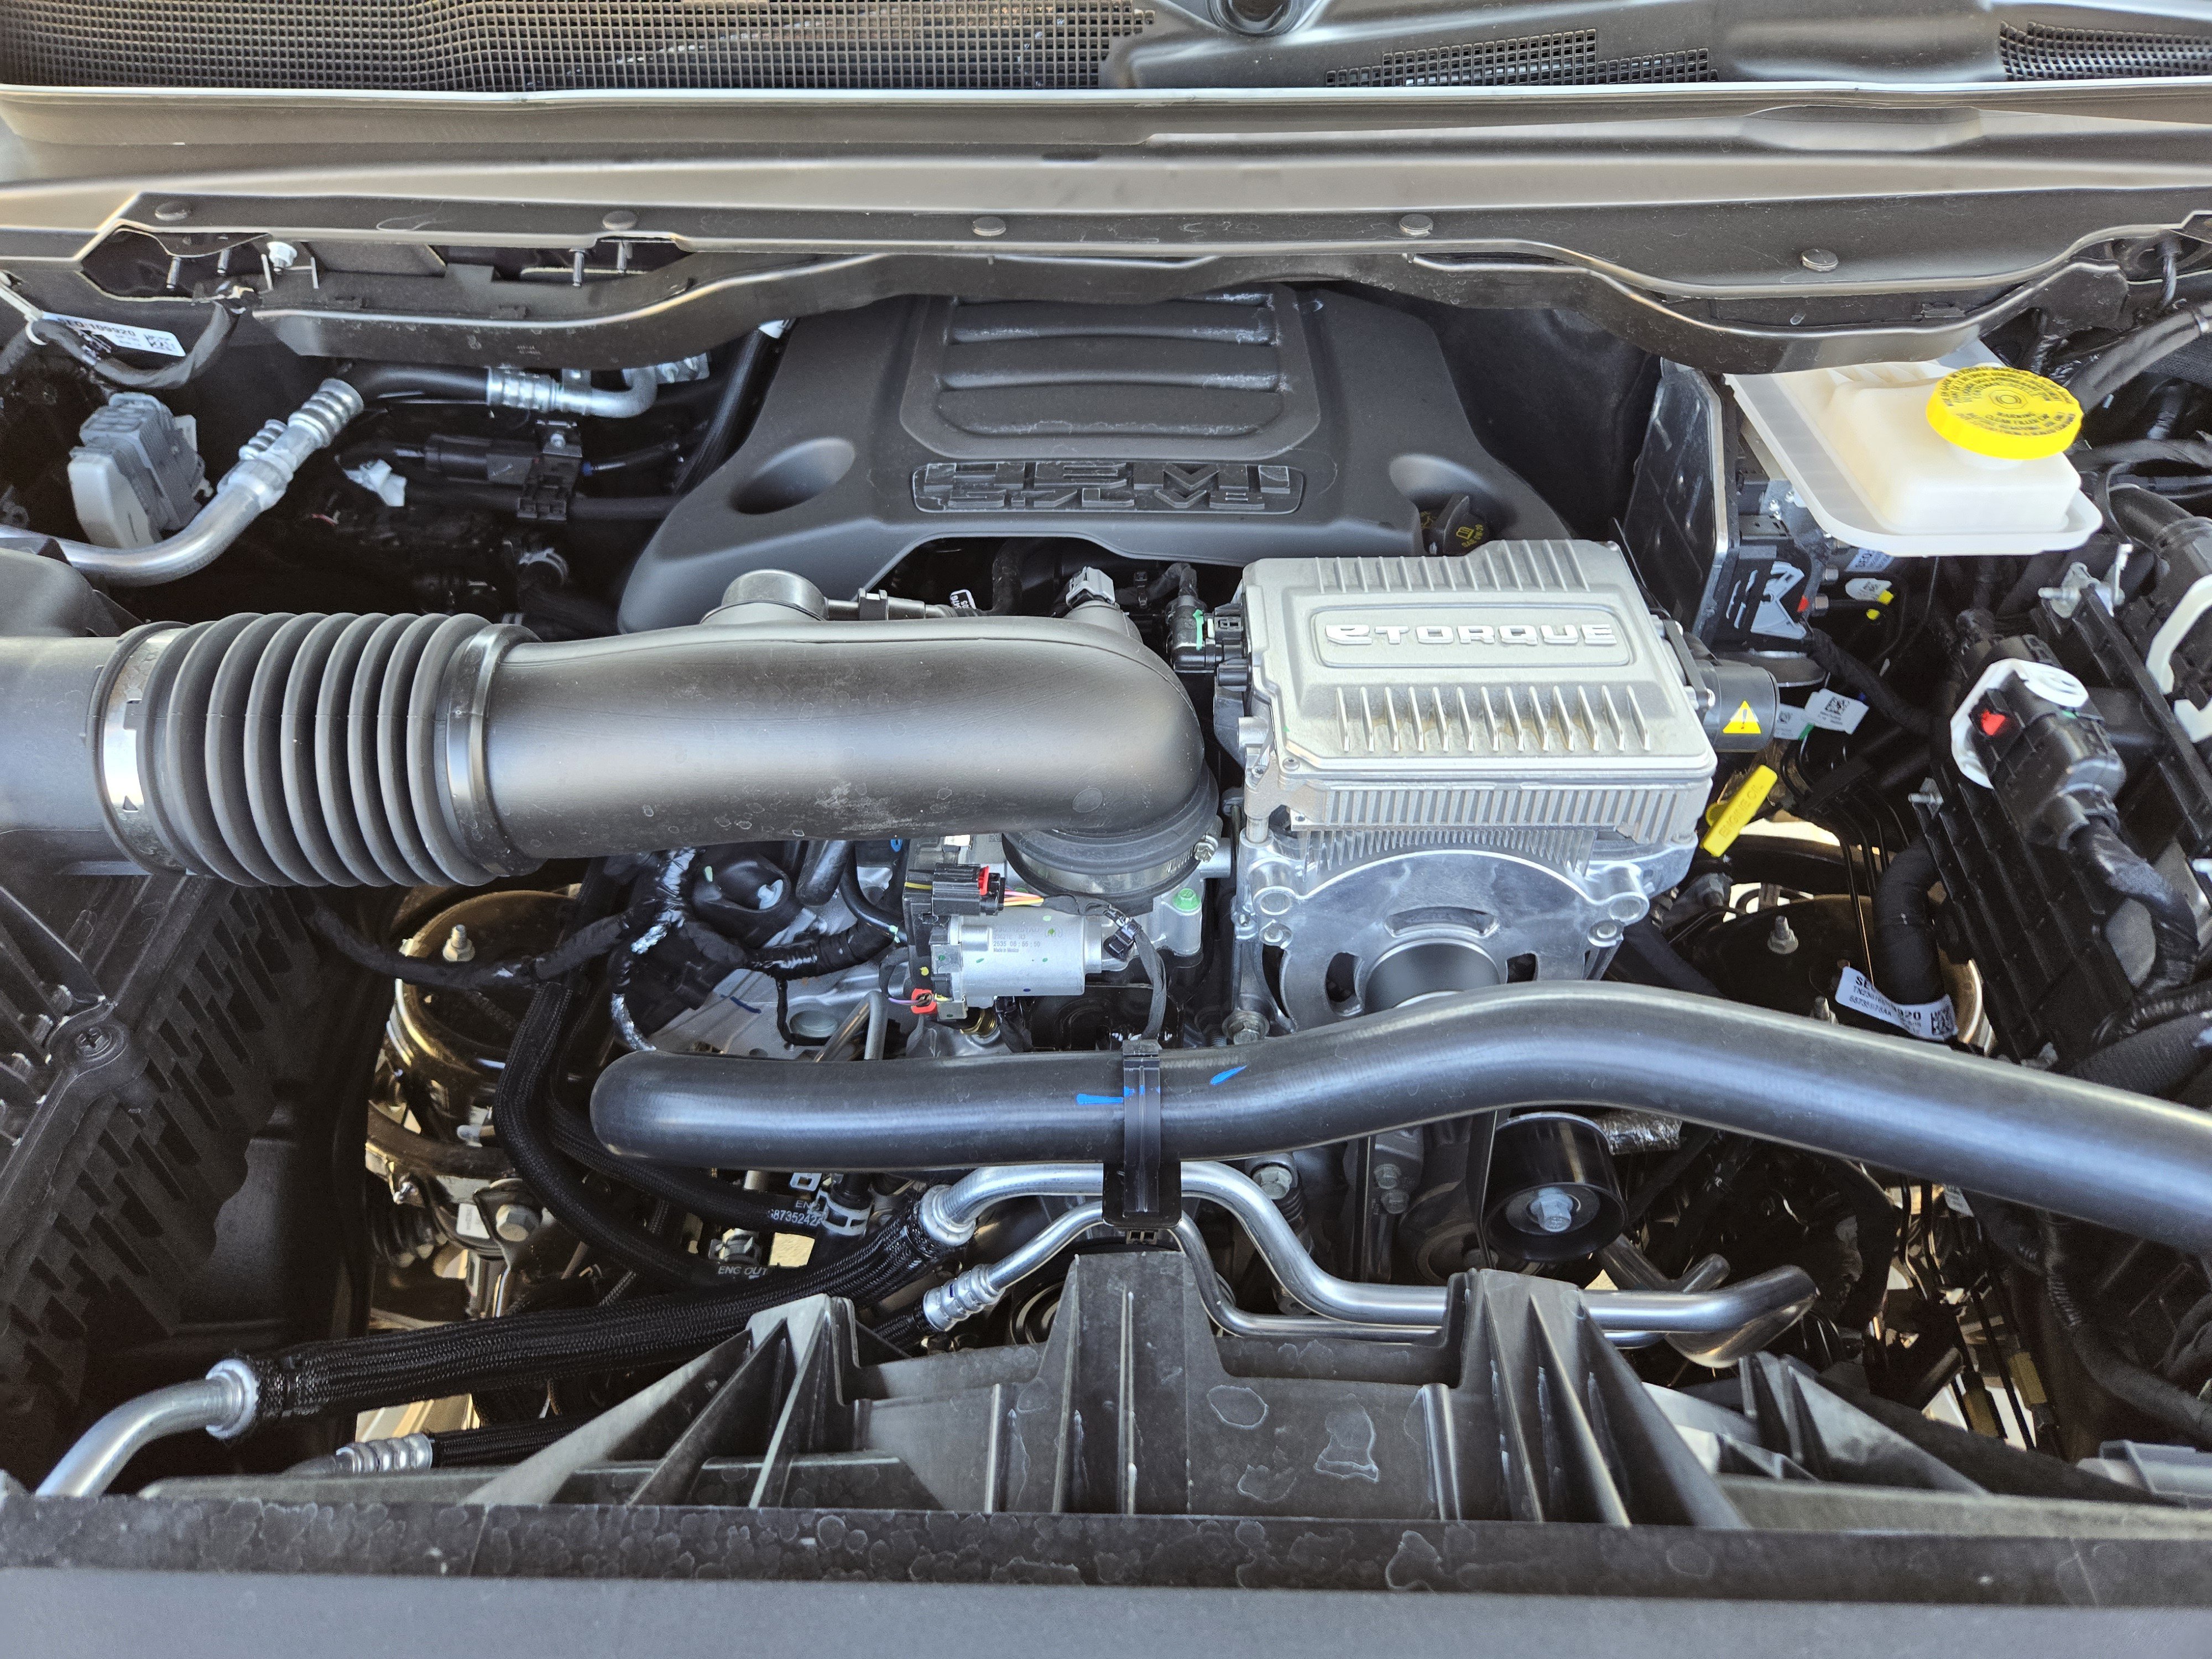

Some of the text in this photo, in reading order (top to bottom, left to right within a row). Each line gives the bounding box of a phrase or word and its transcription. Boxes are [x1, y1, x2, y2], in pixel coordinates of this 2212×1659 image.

[924, 462, 1291, 494] HEMI
[1718, 784, 1764, 839] ENGINE OIL
[718, 1266, 742, 1275] ENG
